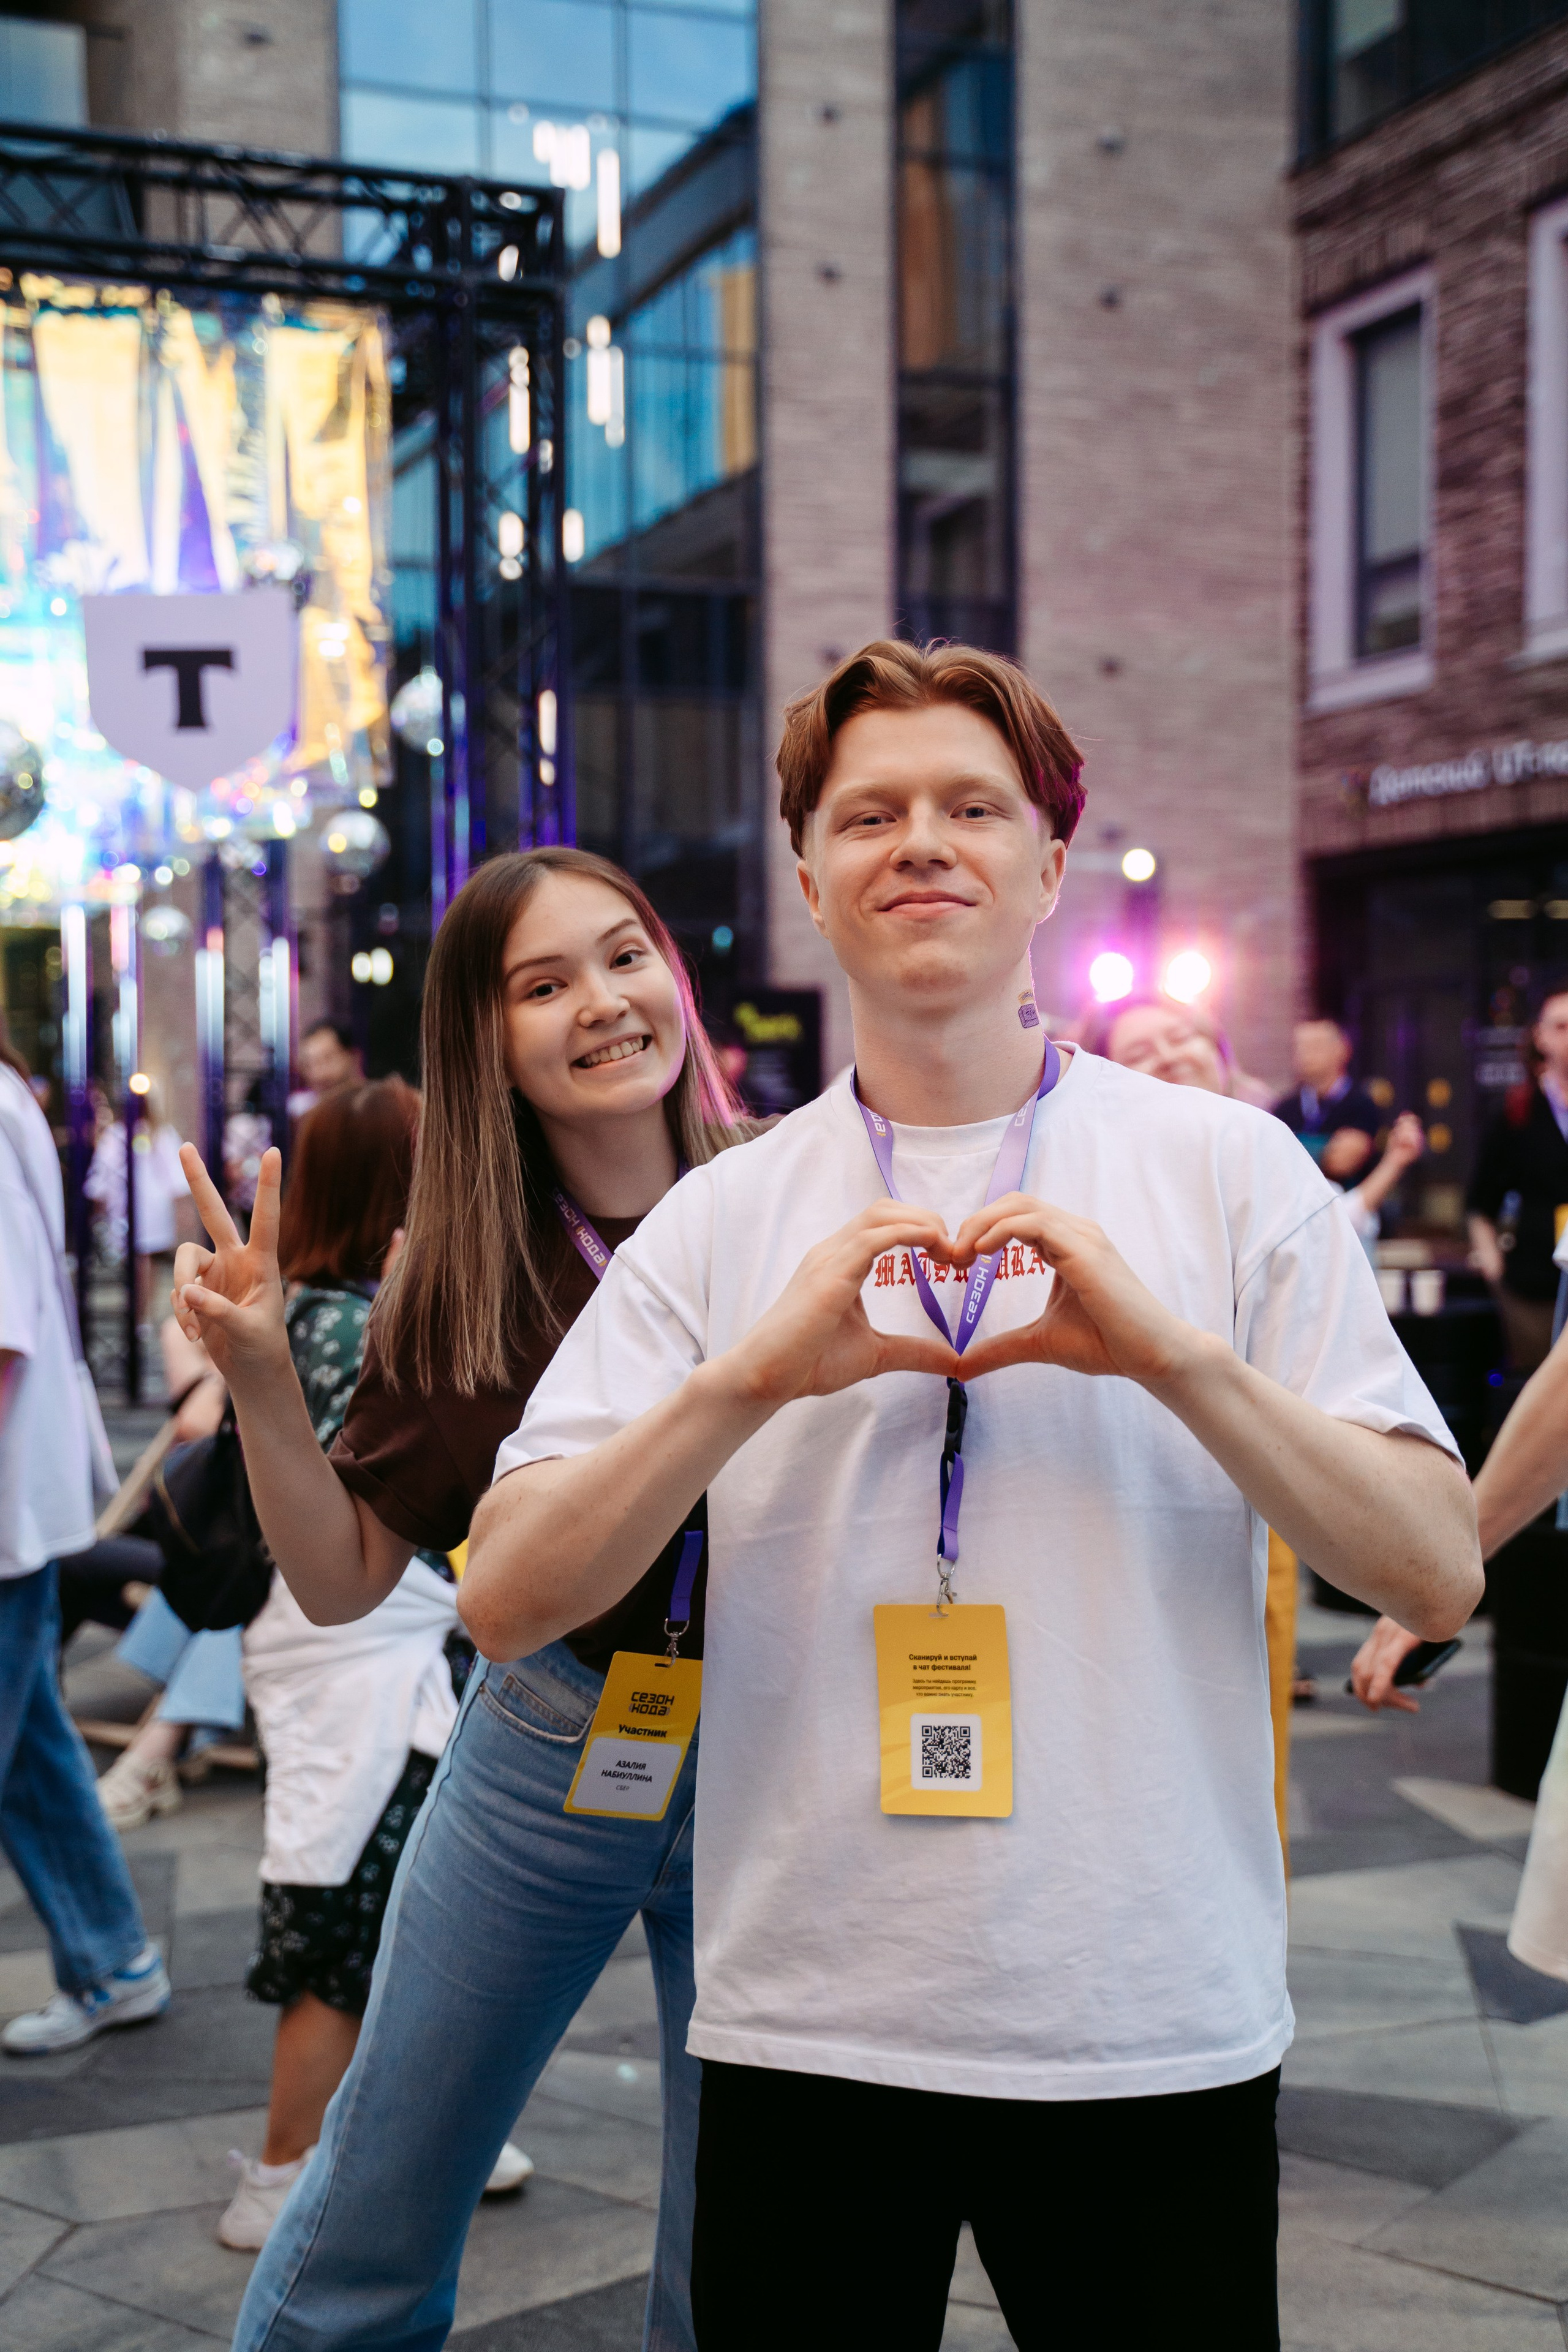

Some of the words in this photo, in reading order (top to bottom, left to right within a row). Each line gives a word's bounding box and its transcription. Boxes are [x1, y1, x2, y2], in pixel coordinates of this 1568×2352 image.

[619, 1724, 667, 1737] Участник
[616, 1760, 646, 1770] АЗАЛИЯ
[601, 1770, 652, 1782] НАБИУЛЛИНА
